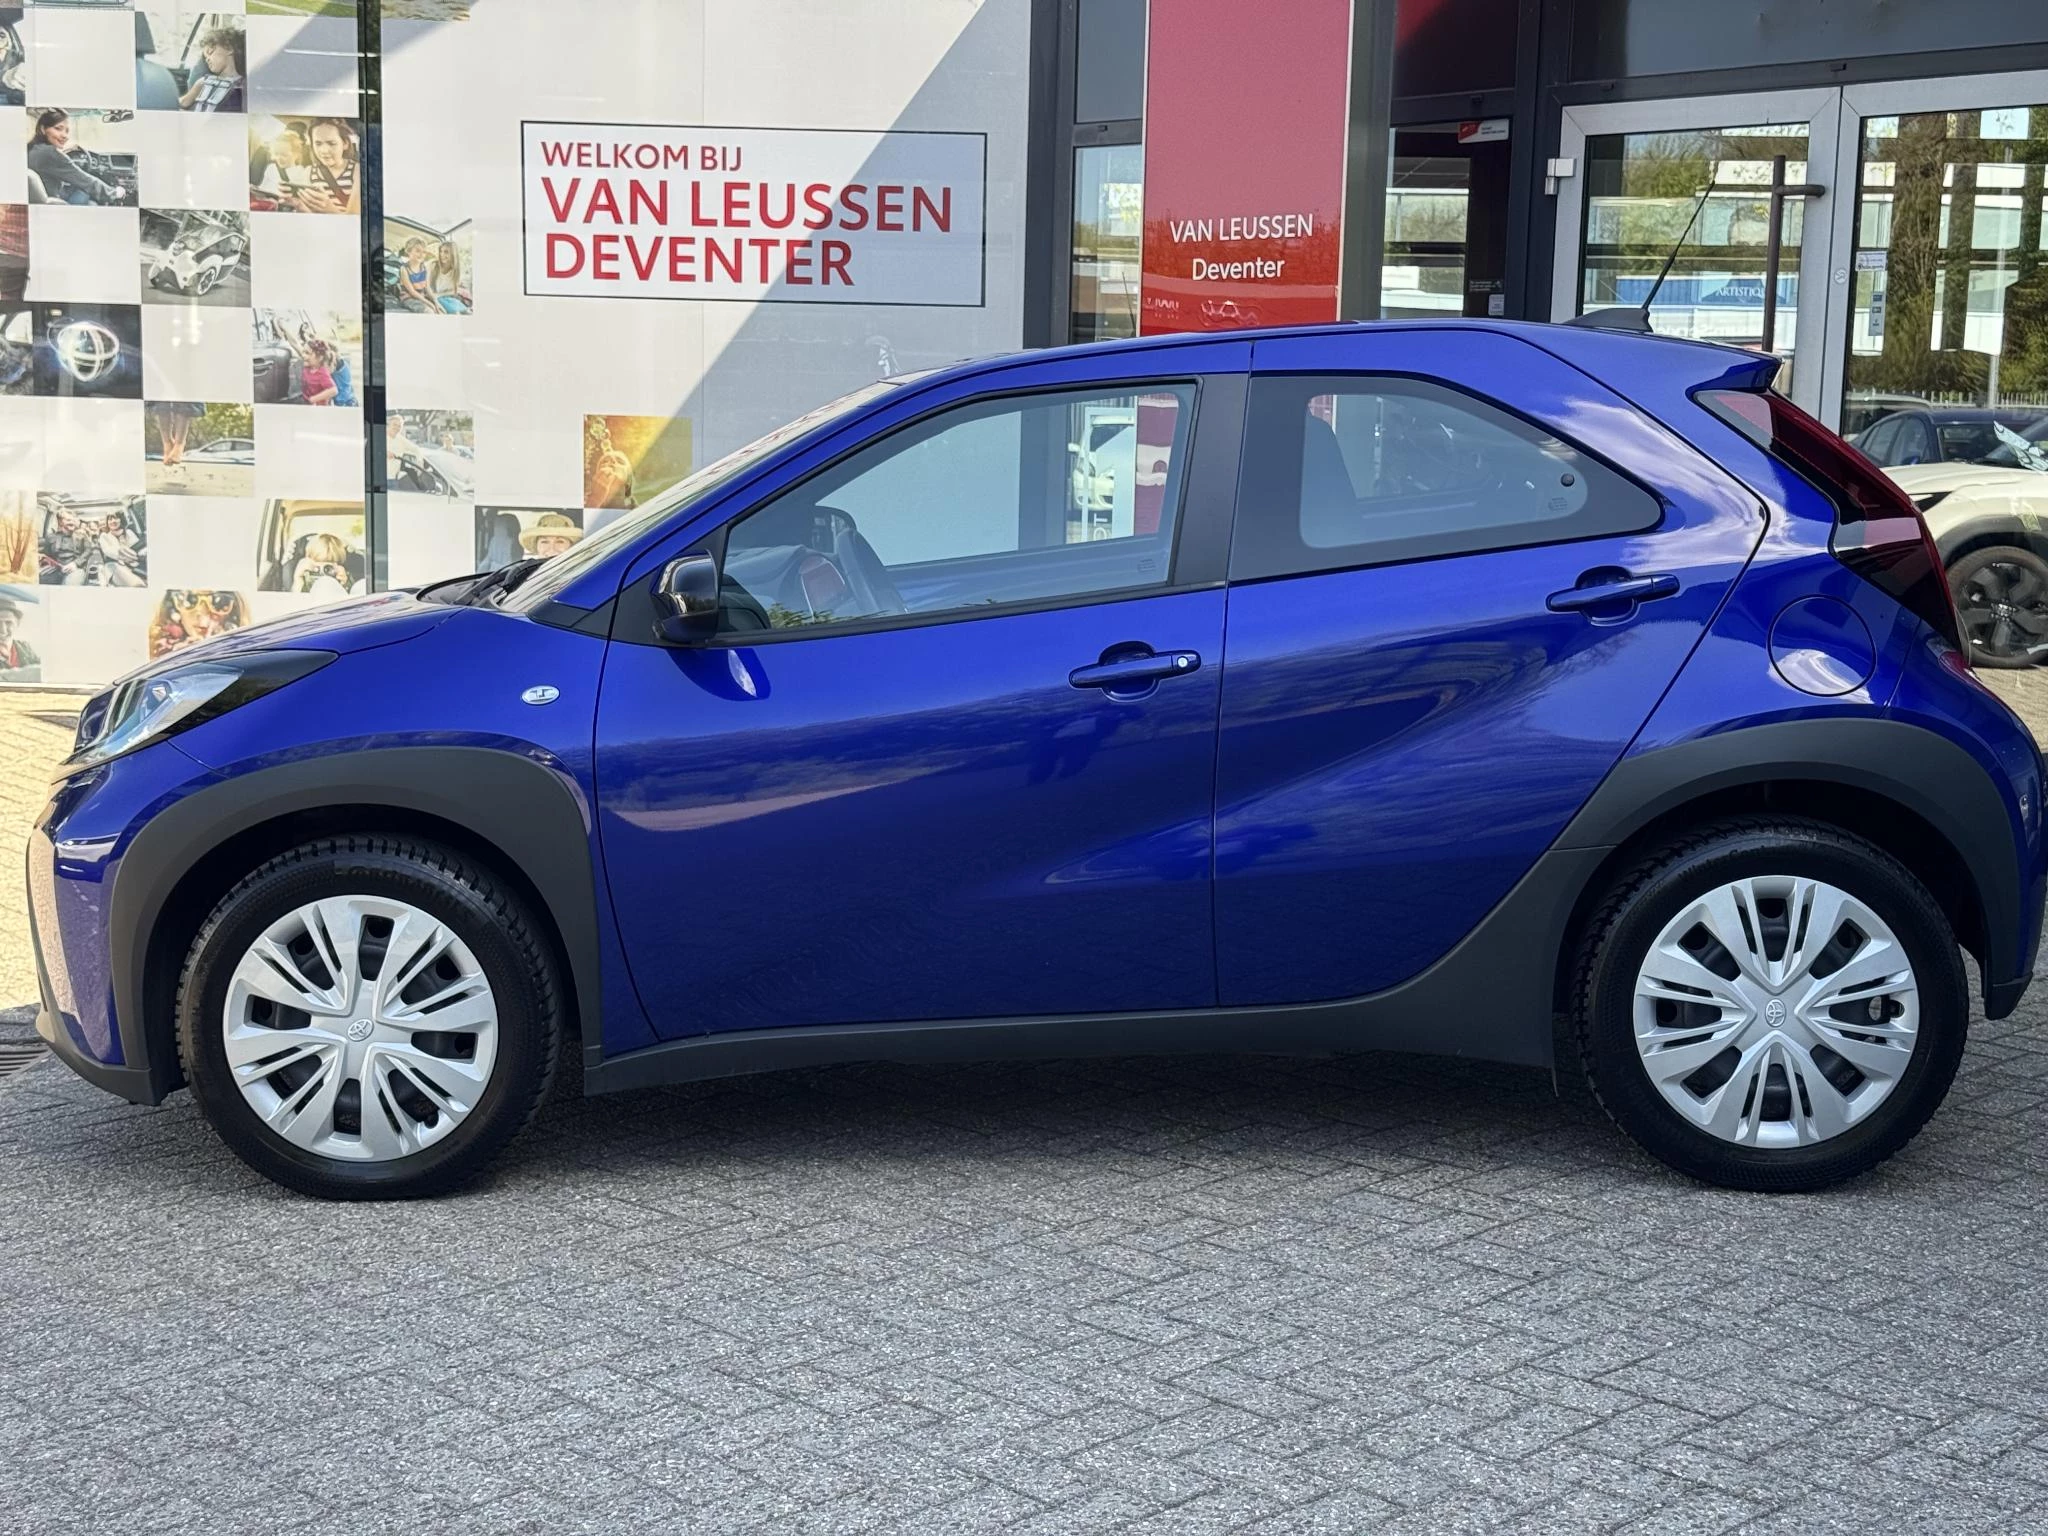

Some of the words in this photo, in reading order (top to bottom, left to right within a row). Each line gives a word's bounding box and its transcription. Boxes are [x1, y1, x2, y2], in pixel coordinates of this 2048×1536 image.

[541, 141, 689, 170] WELKOM
[700, 146, 742, 172] BIJ
[541, 176, 668, 226] VAN
[690, 180, 951, 233] LEUSSEN
[1169, 218, 1213, 244] VAN
[1219, 213, 1314, 241] LEUSSEN
[545, 233, 855, 287] DEVENTER
[1192, 256, 1286, 281] Deventer
